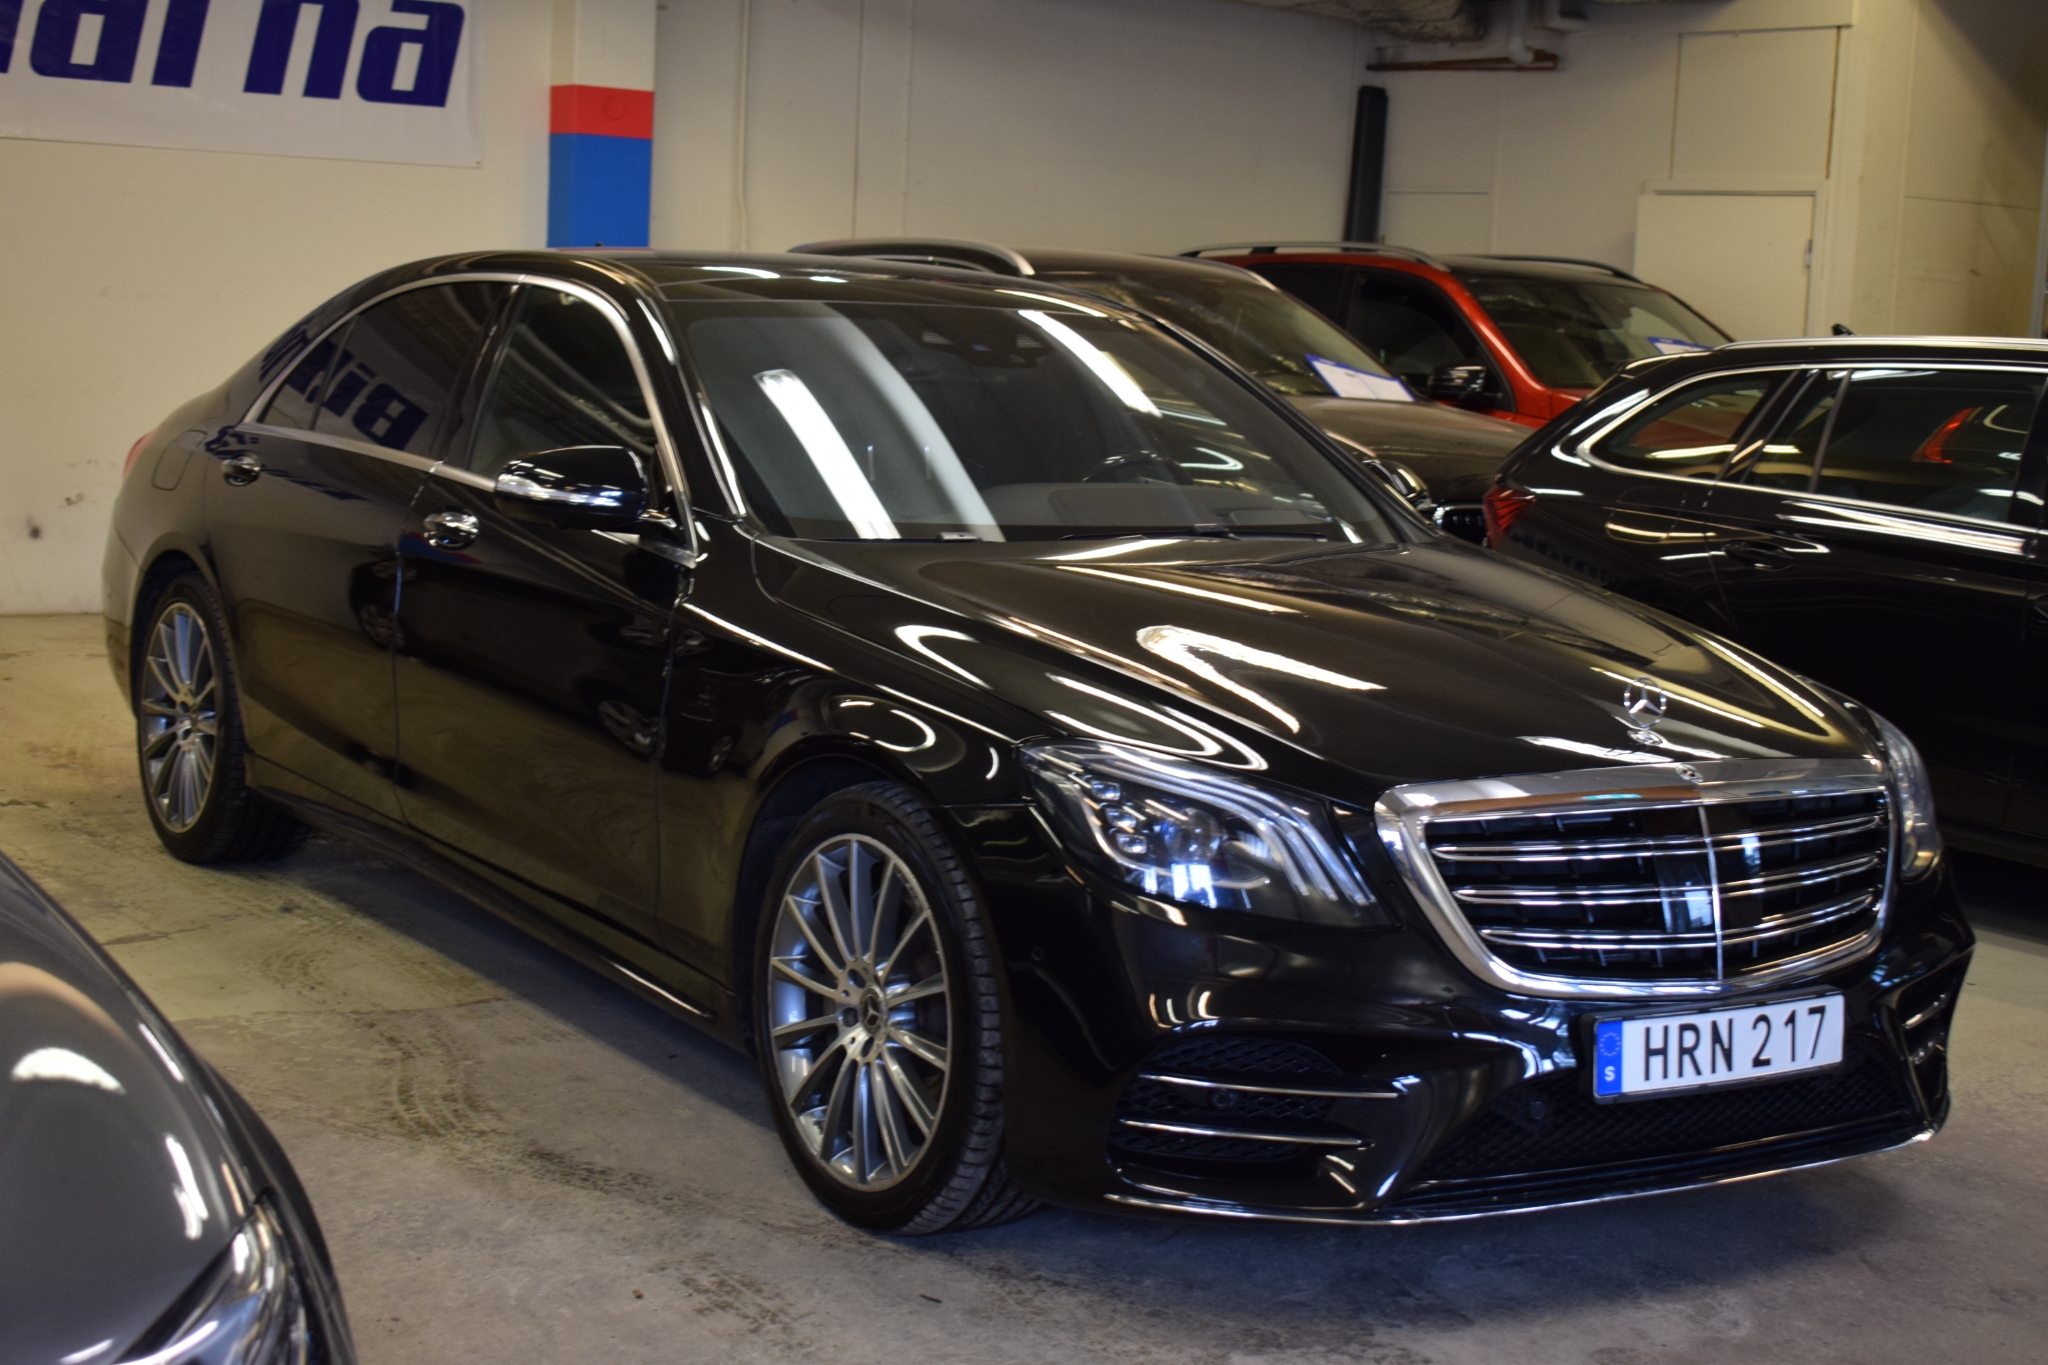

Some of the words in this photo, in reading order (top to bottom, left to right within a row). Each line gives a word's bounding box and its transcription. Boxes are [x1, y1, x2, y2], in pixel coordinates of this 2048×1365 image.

[0, 0, 465, 107] arna
[1604, 1066, 1616, 1081] S
[1643, 1018, 1734, 1081] HRN
[1752, 1005, 1826, 1067] 217
